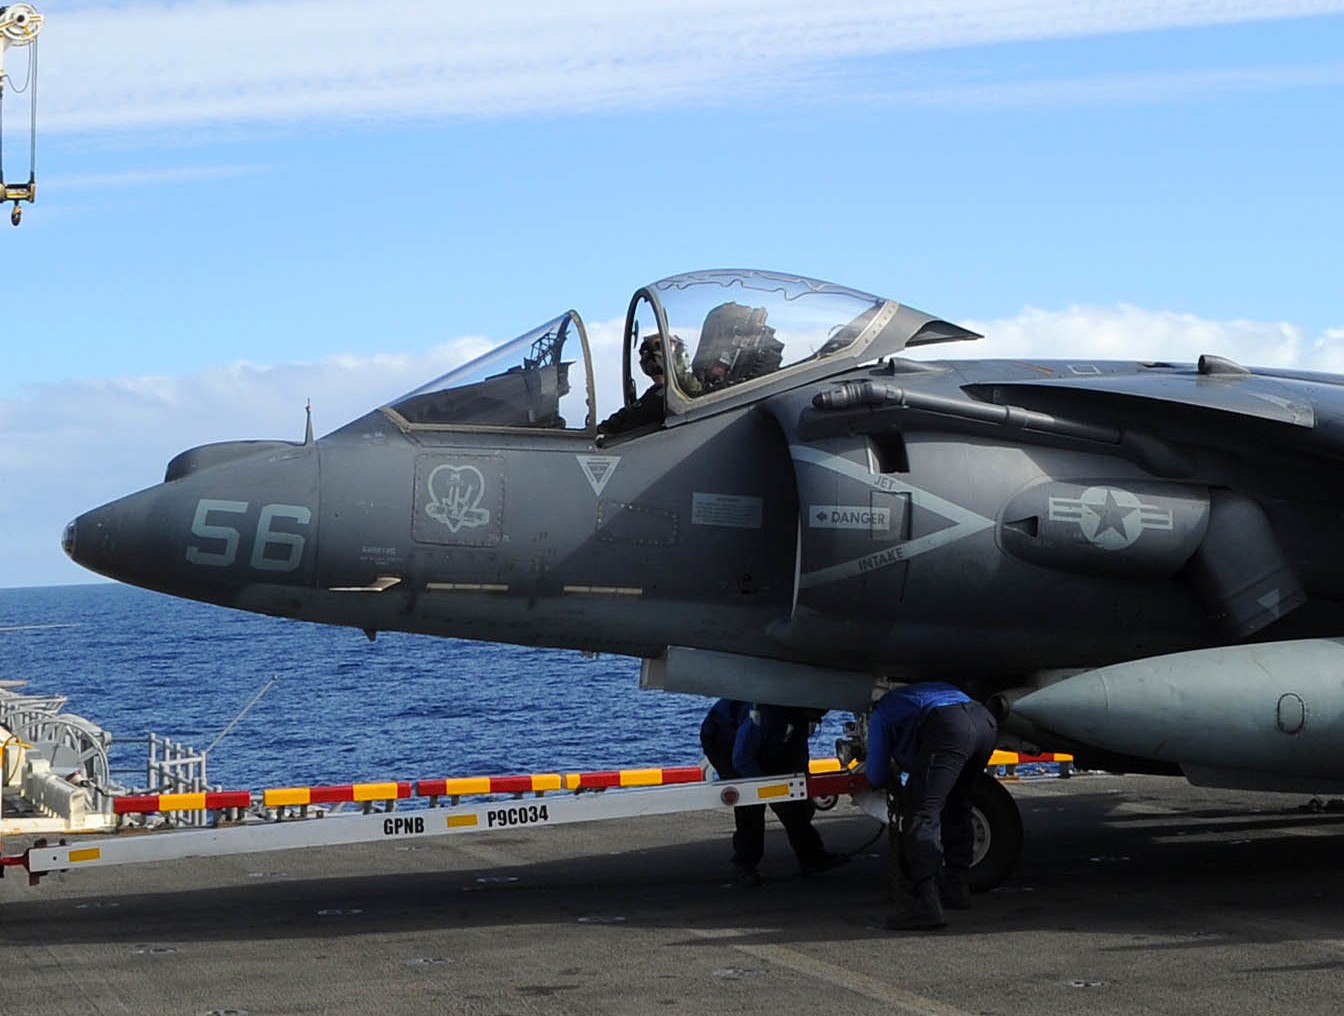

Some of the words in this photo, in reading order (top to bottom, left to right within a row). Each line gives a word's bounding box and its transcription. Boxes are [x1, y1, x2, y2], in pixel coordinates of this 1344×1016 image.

[874, 475, 895, 489] JET
[831, 511, 885, 525] DANGER
[185, 499, 312, 572] 56
[858, 547, 904, 571] INTAKE
[383, 817, 425, 835] GPNB
[487, 805, 549, 828] P9C034
